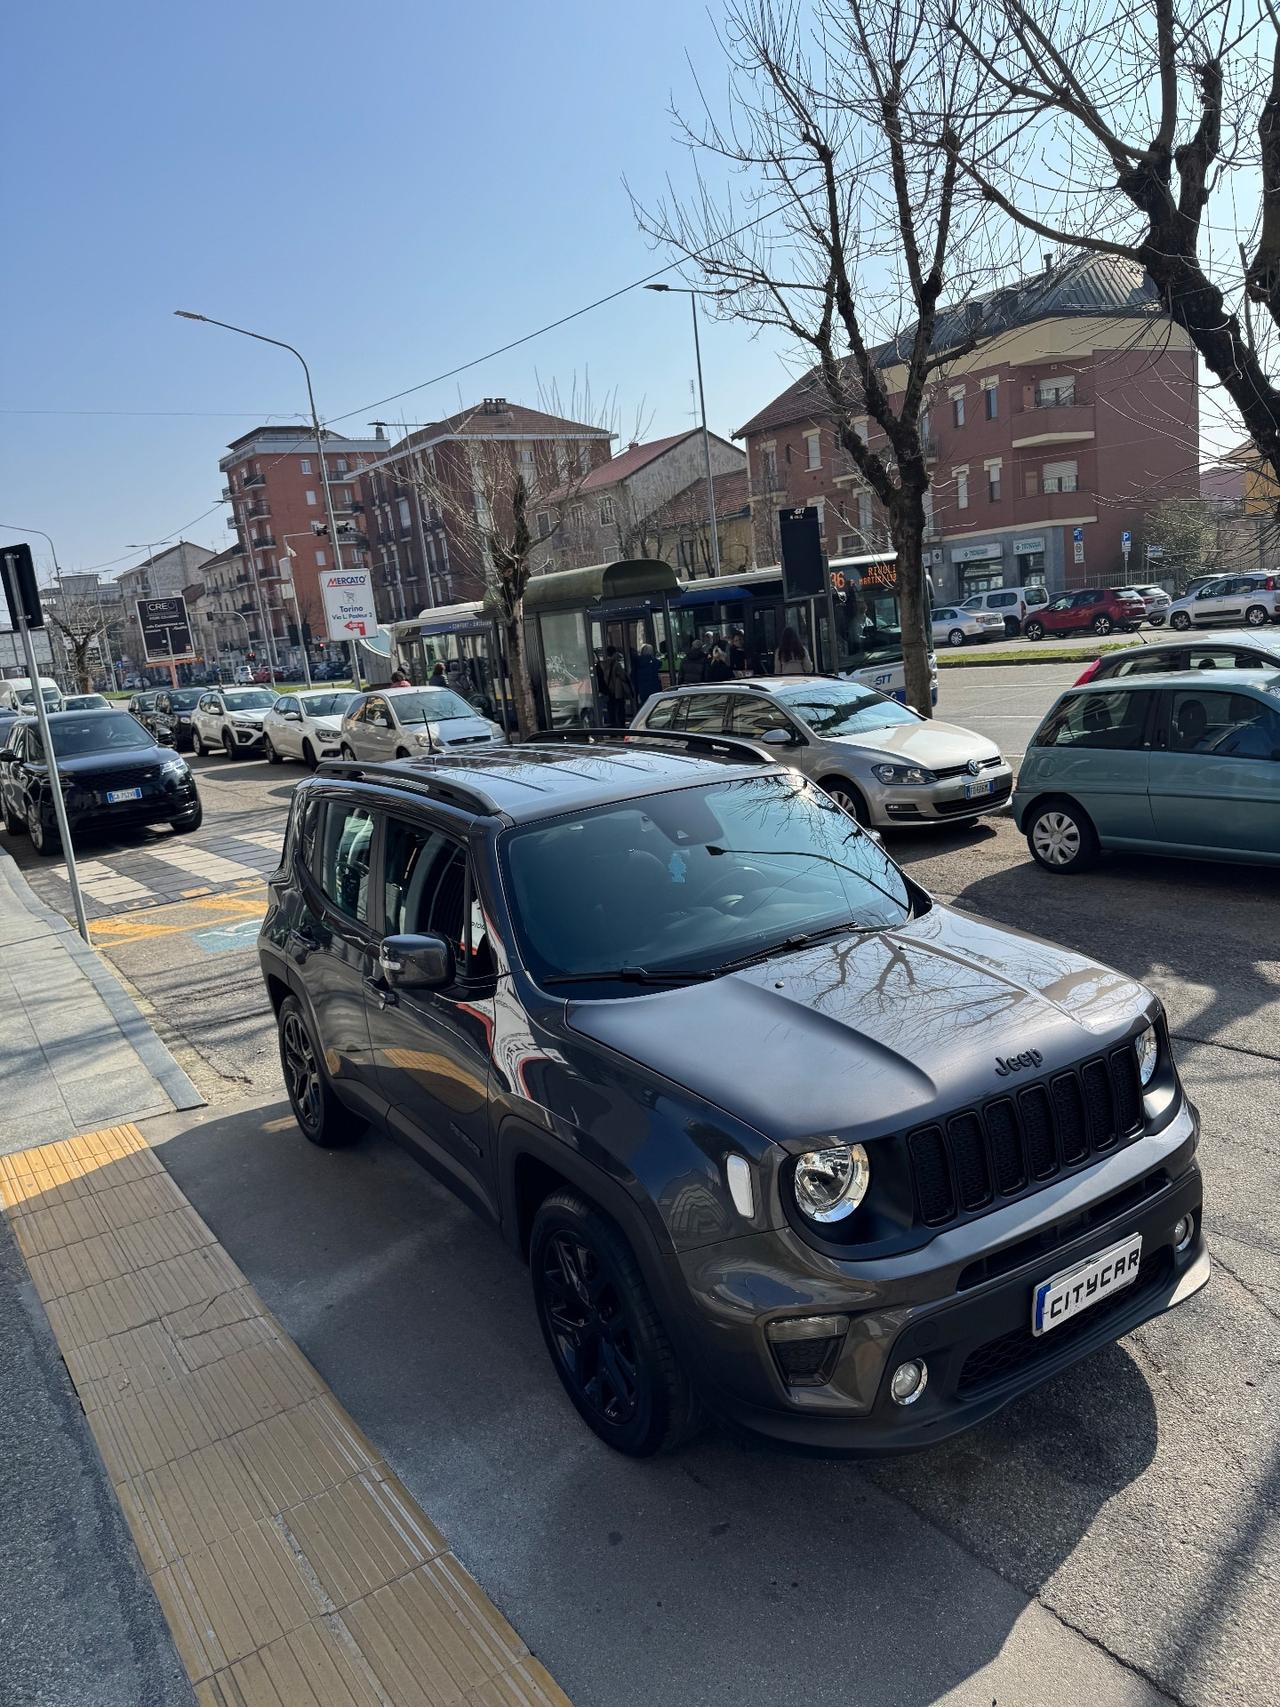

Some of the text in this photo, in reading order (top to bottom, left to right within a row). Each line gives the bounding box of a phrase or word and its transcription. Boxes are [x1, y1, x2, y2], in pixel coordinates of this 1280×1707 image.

[340, 605, 364, 613] Torino
[994, 1047, 1044, 1077] Jeep
[1050, 1248, 1140, 1319] CITYCAR
